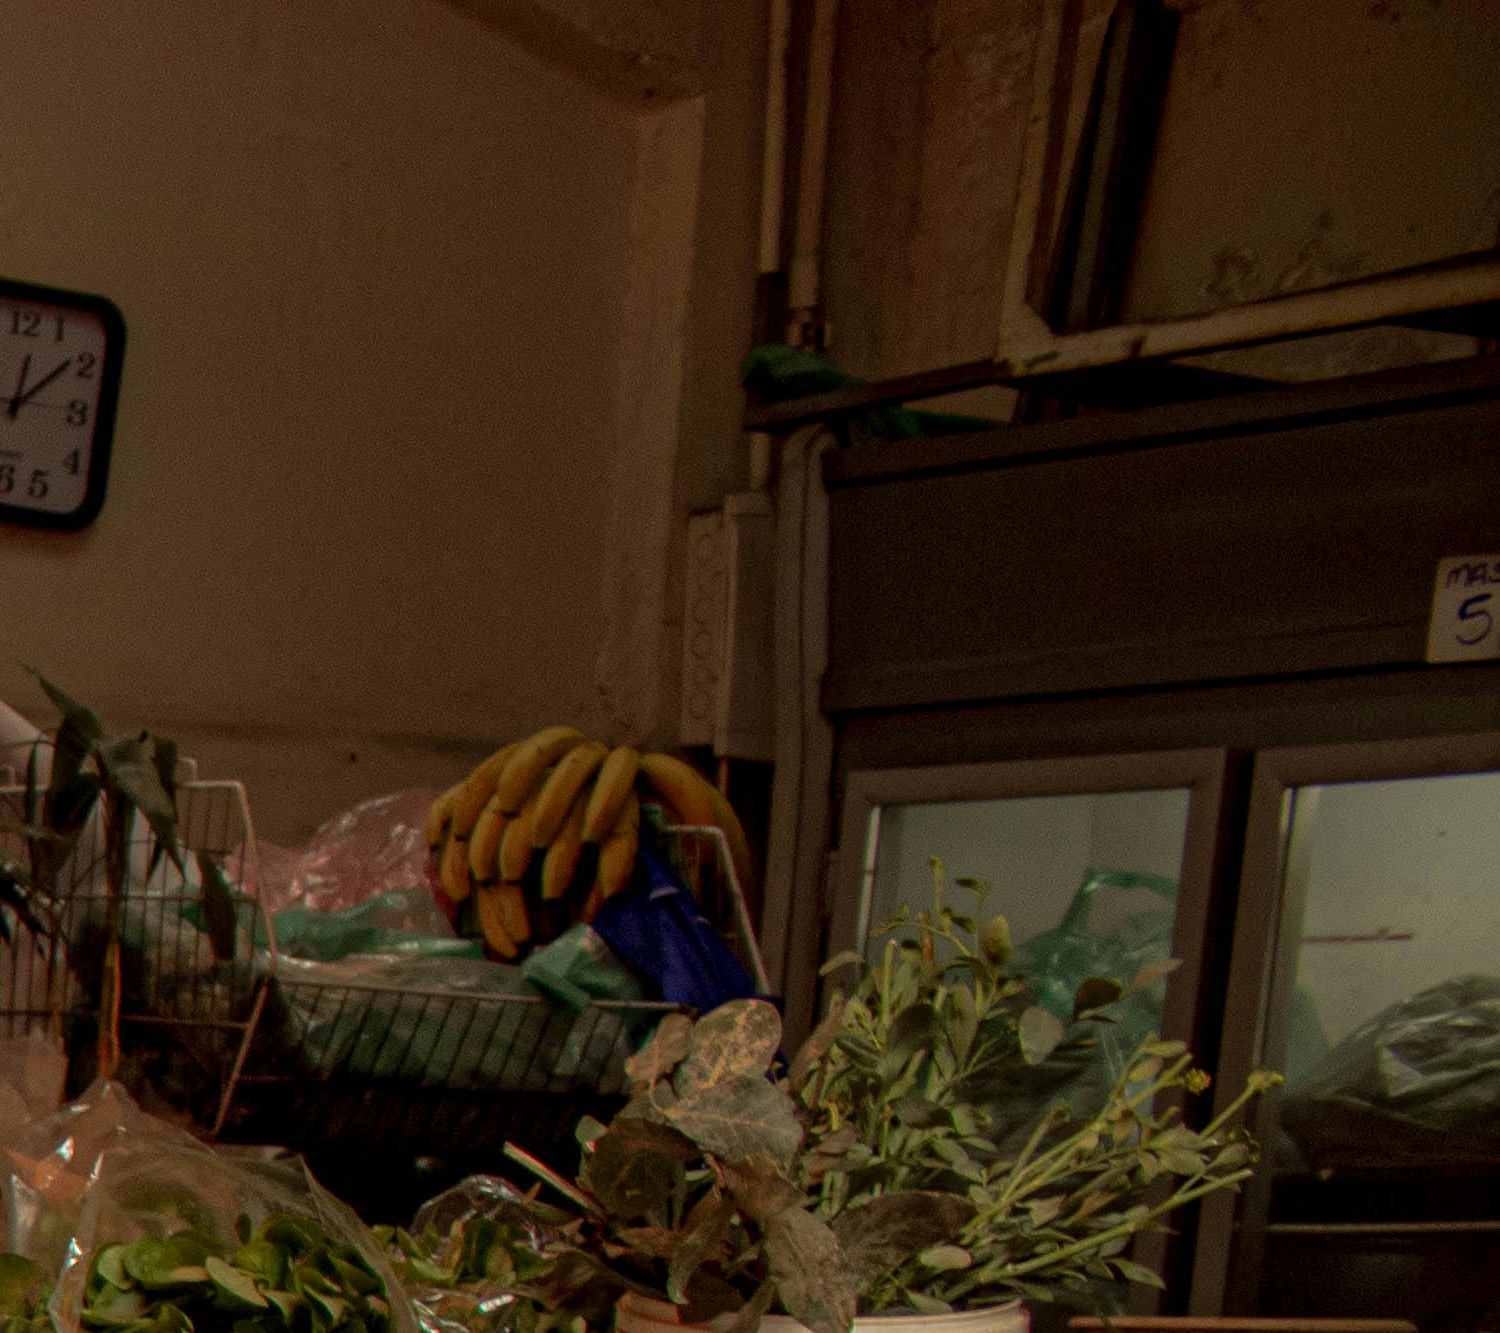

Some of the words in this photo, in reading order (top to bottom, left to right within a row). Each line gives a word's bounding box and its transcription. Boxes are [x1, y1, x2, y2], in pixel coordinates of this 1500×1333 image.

[11, 309, 40, 337] 12
[54, 317, 68, 342] 1
[77, 351, 95, 379] 2
[66, 400, 88, 427] 3
[62, 449, 80, 476] 4
[27, 470, 49, 499] 5
[1455, 593, 1493, 646] 5
